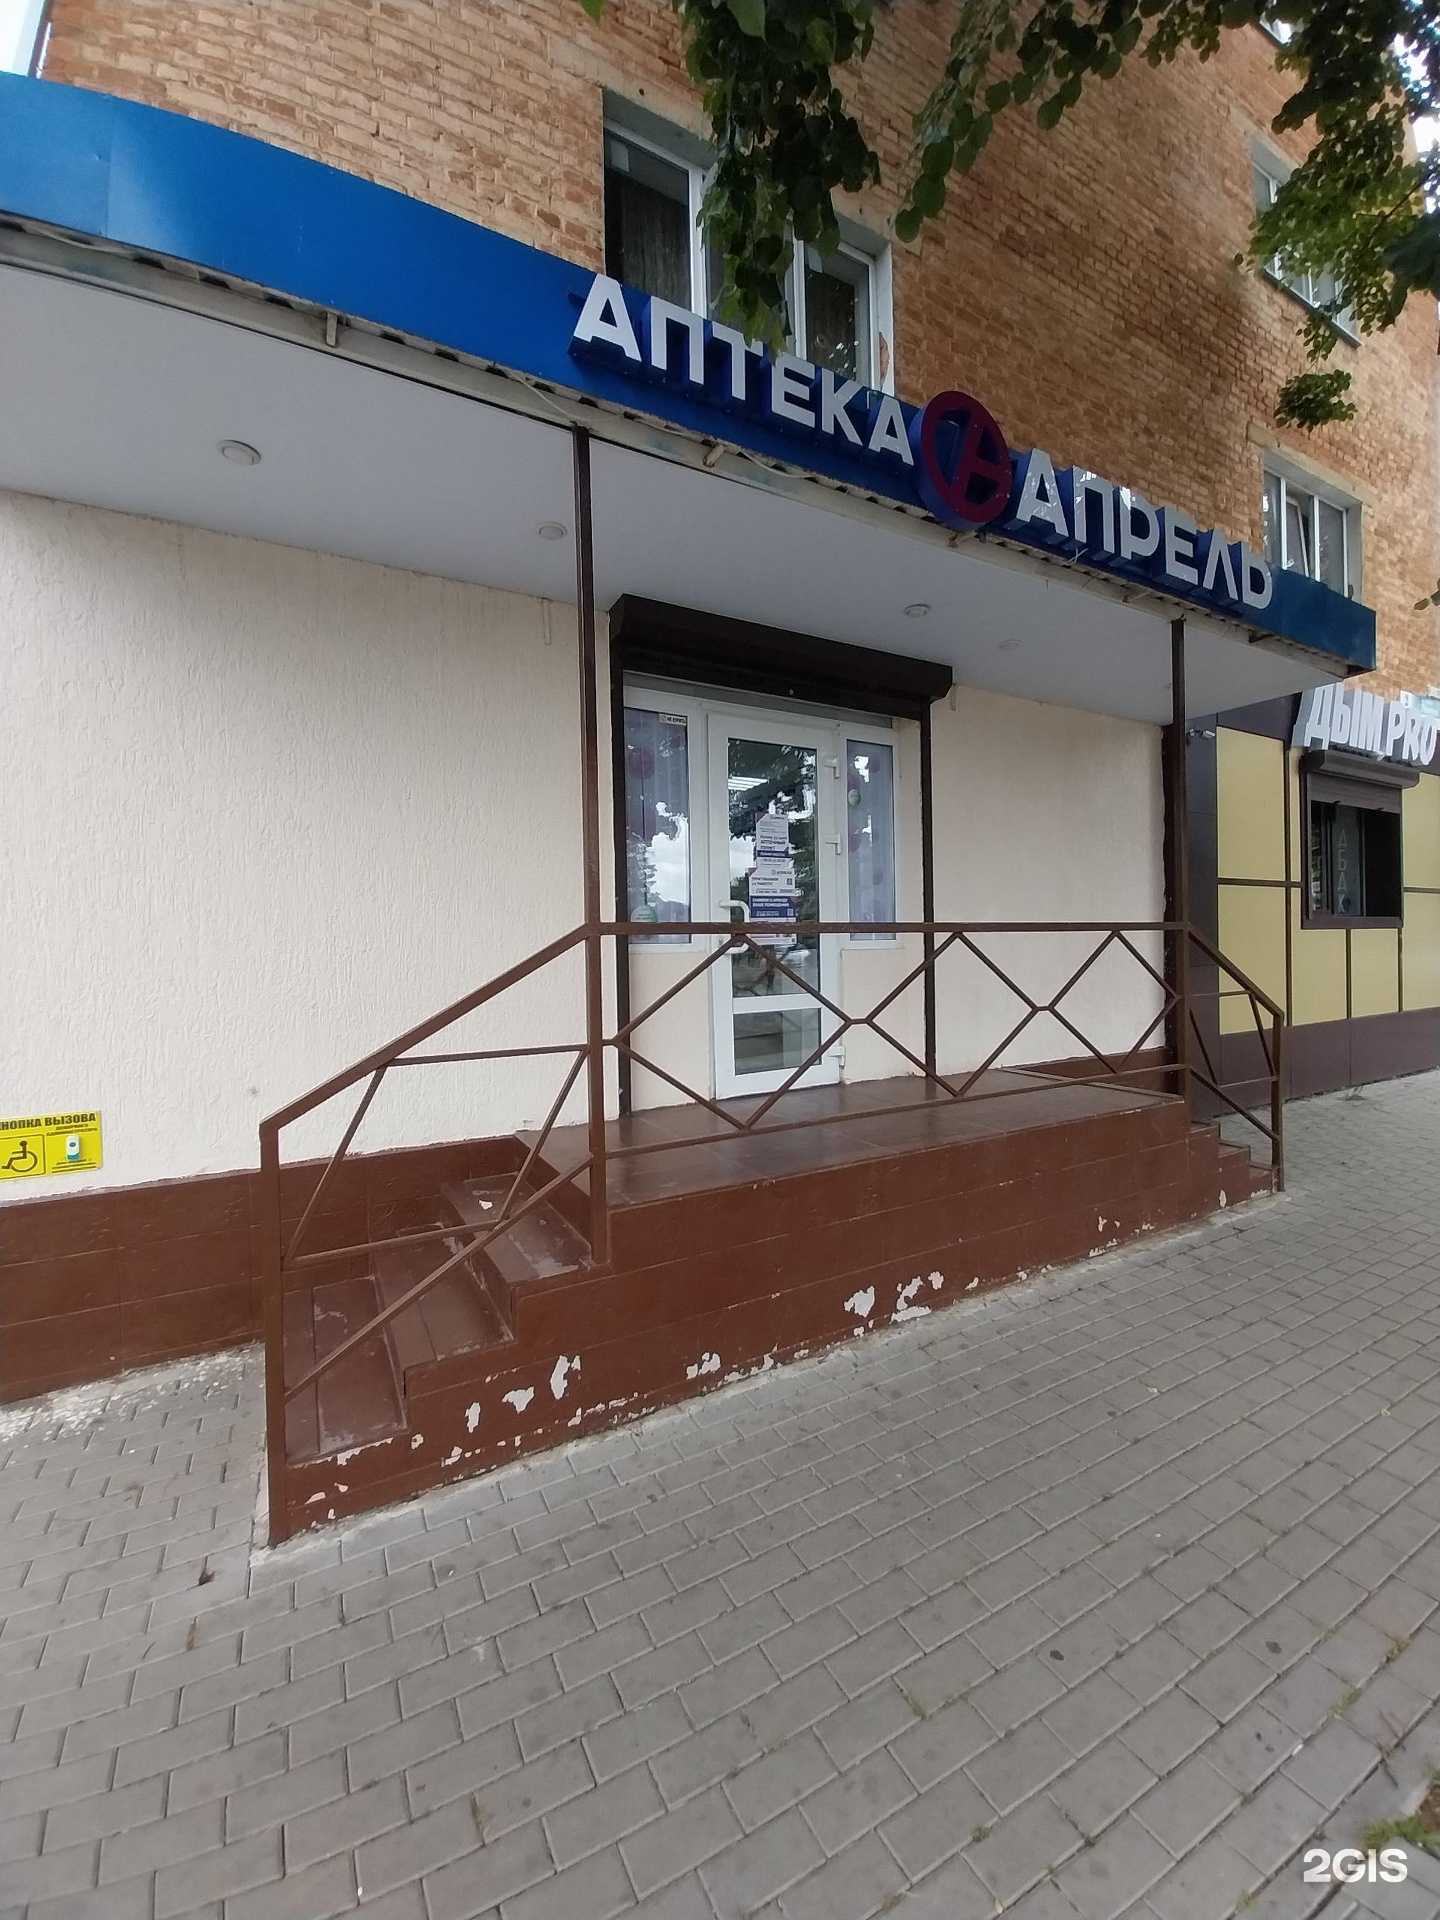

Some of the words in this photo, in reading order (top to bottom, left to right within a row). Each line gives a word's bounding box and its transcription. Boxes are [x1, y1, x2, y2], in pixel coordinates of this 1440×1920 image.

[573, 273, 914, 466] АПТЕКА
[1015, 448, 1273, 610] АПРЕЛЬ
[0, 1118, 42, 1131] НОПКА
[44, 1113, 96, 1126] ВЫЗОВА
